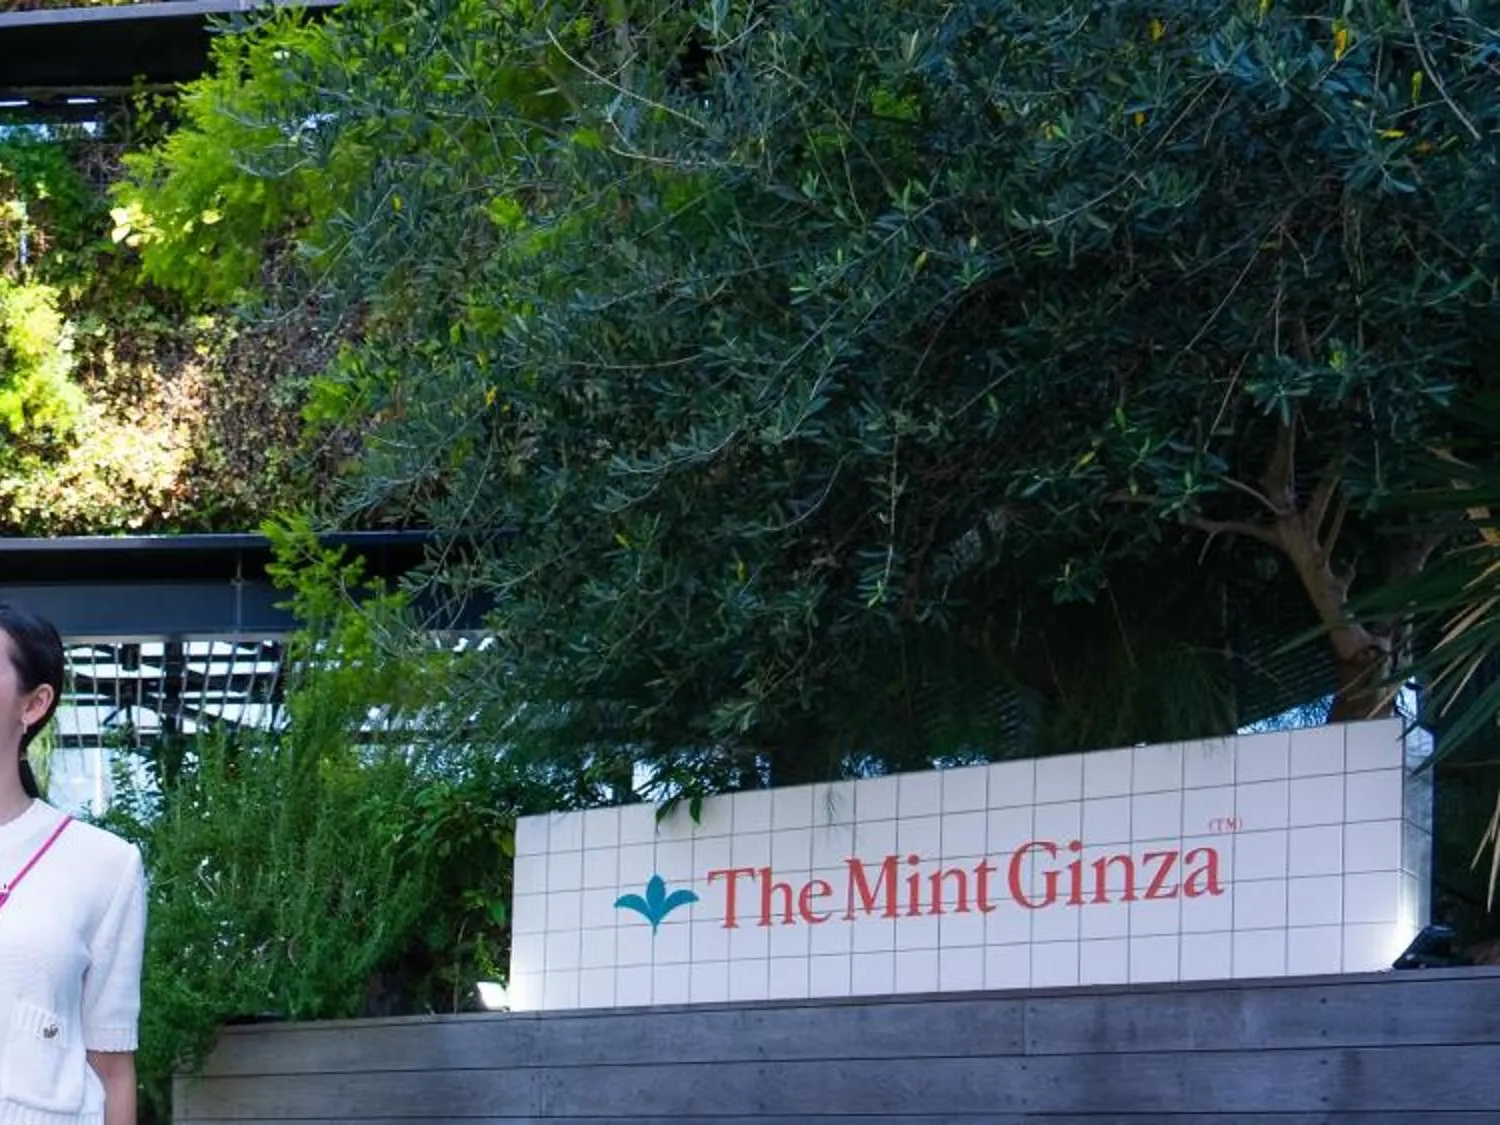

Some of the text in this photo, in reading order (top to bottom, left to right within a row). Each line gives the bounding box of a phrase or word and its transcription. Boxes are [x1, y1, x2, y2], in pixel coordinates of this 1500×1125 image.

[707, 866, 833, 930] The
[842, 853, 996, 921] Mint
[1007, 840, 1225, 909] Ginza
